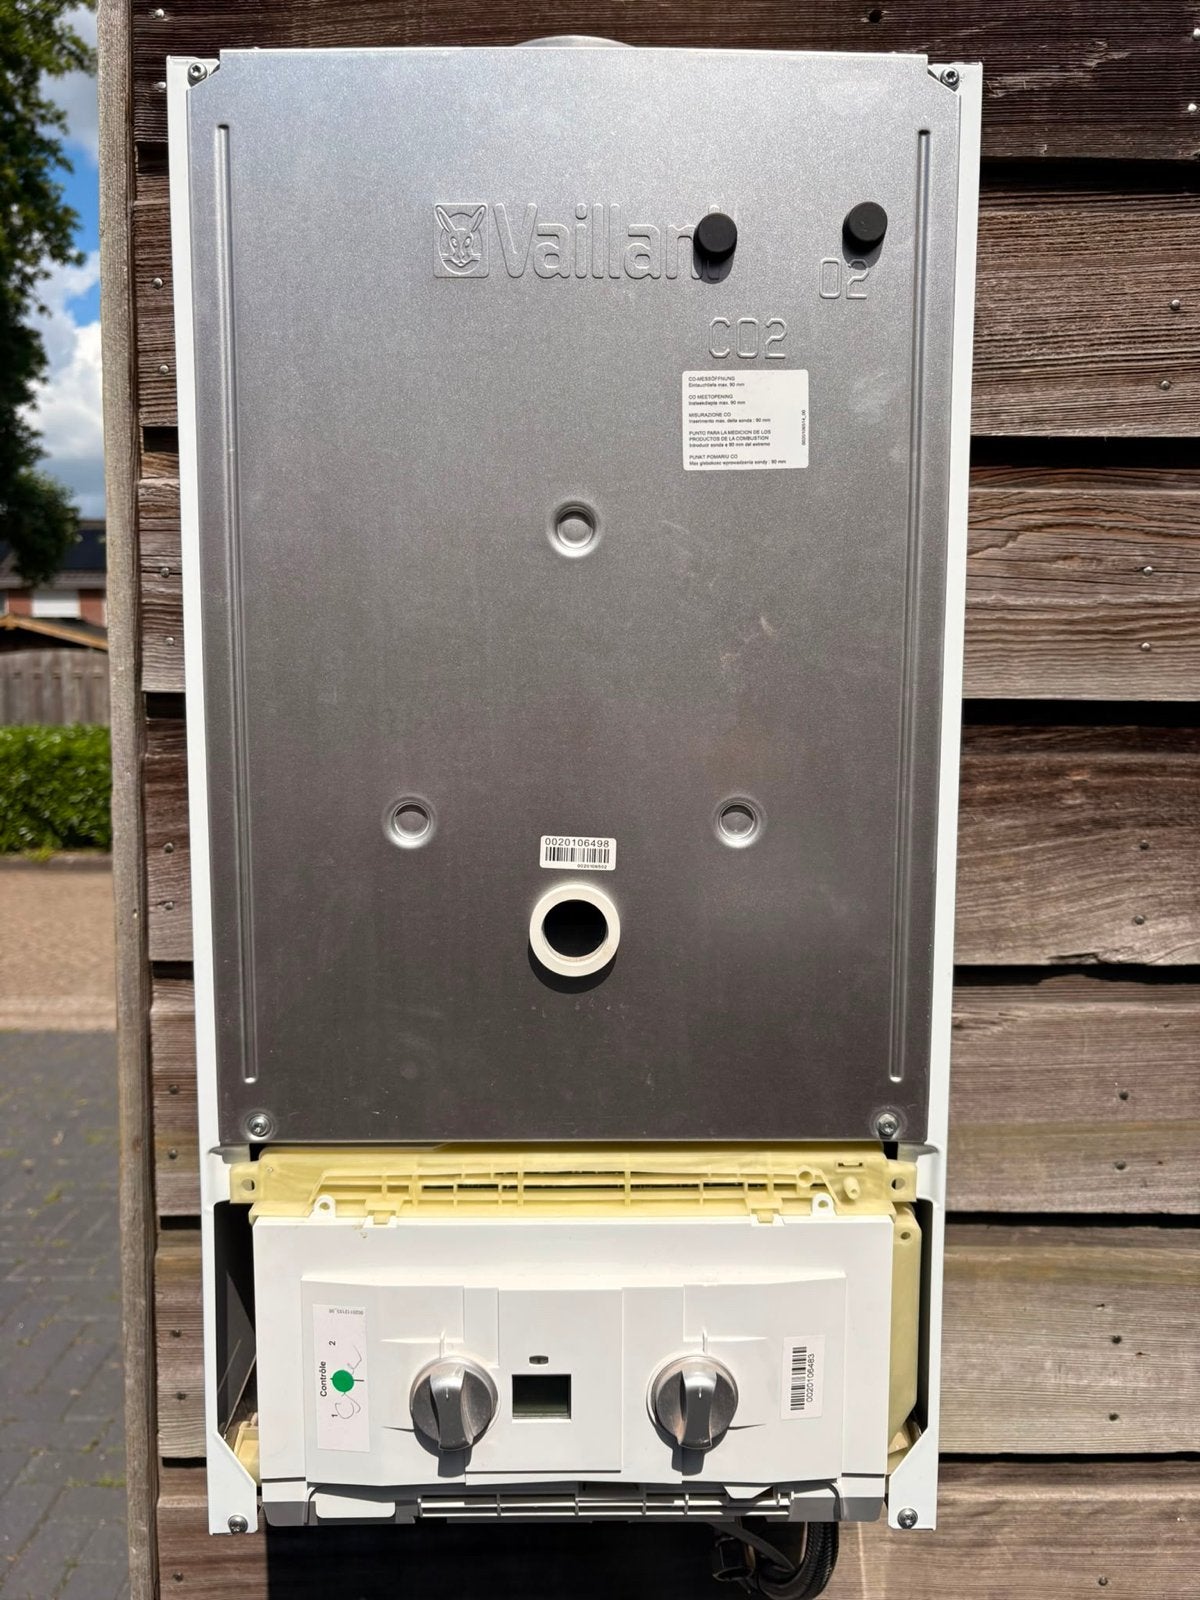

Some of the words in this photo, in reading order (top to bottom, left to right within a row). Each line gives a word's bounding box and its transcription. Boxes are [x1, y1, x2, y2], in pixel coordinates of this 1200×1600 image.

[545, 838, 610, 848] 0020106498
[320, 1361, 328, 1397] Contrôle
[806, 1354, 815, 1402] 0020106483
